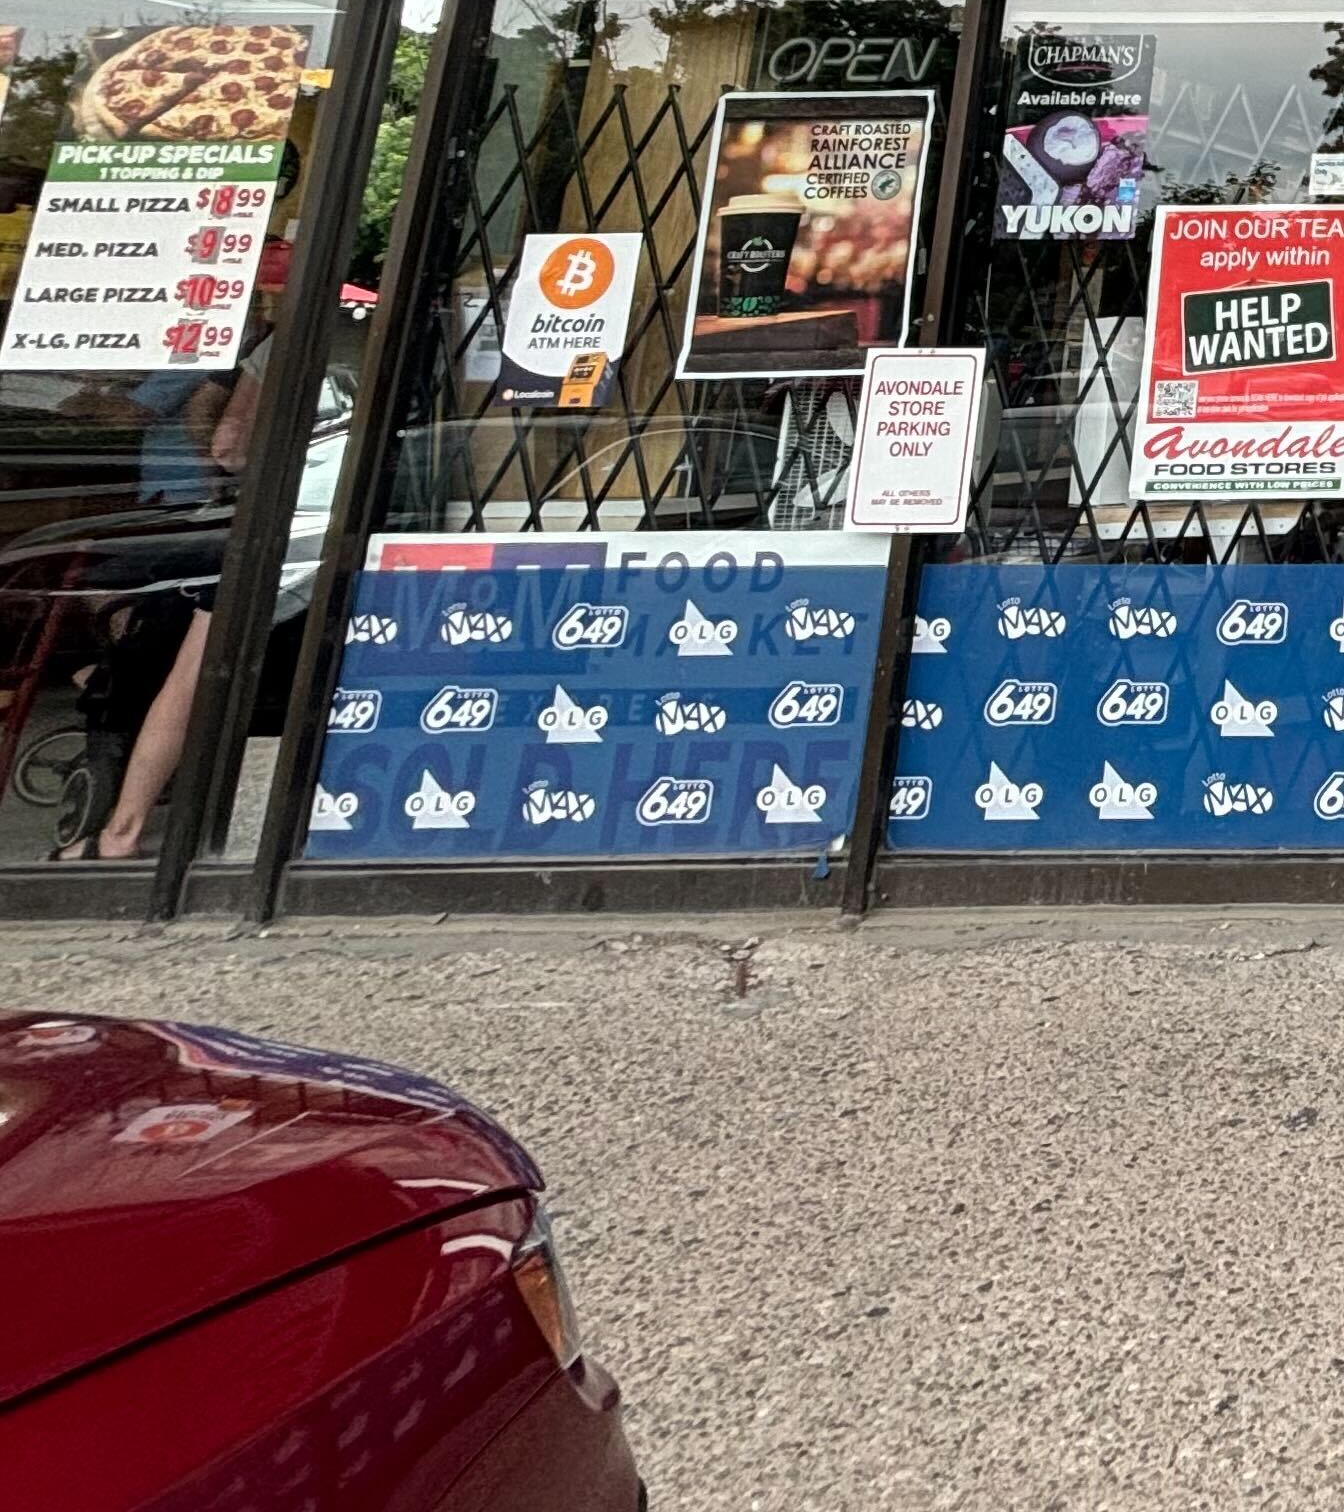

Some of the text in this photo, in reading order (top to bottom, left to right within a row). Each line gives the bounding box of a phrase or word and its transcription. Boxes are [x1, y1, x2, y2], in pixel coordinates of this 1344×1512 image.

[769, 38, 940, 82] OPEN
[1034, 46, 1135, 67] CHAPMAN'S
[1017, 90, 1142, 105] Available Here
[811, 123, 911, 136] CRAFT ROASTED
[810, 138, 910, 152] RAINFOREST
[57, 144, 275, 165] PICK-UP SPECIALS
[807, 153, 907, 170] ALLIANCE
[99, 167, 224, 181] 1 TOPPING & DIP
[806, 172, 870, 185] CERTIFIED
[804, 186, 868, 200] COFFEES
[48, 198, 120, 213] SMALL
[125, 198, 190, 212] PIZZA
[1001, 205, 1134, 235] YUKON
[1170, 219, 1228, 240] JOIN
[1234, 218, 1289, 239] OUR
[35, 242, 88, 258] MED.
[94, 242, 158, 257] PIZZA
[1200, 245, 1330, 271] apply within
[24, 288, 100, 303] LARGE
[103, 287, 168, 303] PIZZA
[1215, 292, 1302, 331] HELP
[531, 313, 605, 333] bitcoin
[11, 334, 70, 350] X-LG.
[74, 334, 141, 349] PIZZA
[528, 336, 601, 349] ATM HERE
[1188, 322, 1329, 366] WANTED
[875, 380, 965, 396] AVONDALE
[888, 401, 945, 416] STORE
[876, 421, 951, 436] PARKING
[889, 441, 934, 457] ONLY
[1154, 462, 1337, 476] FOOD STORES
[1153, 479, 1334, 490] CONVENIENCE WITH LOW PRICES
[618, 551, 786, 593] FOOD
[557, 610, 622, 644] 649
[1221, 605, 1284, 640] 649
